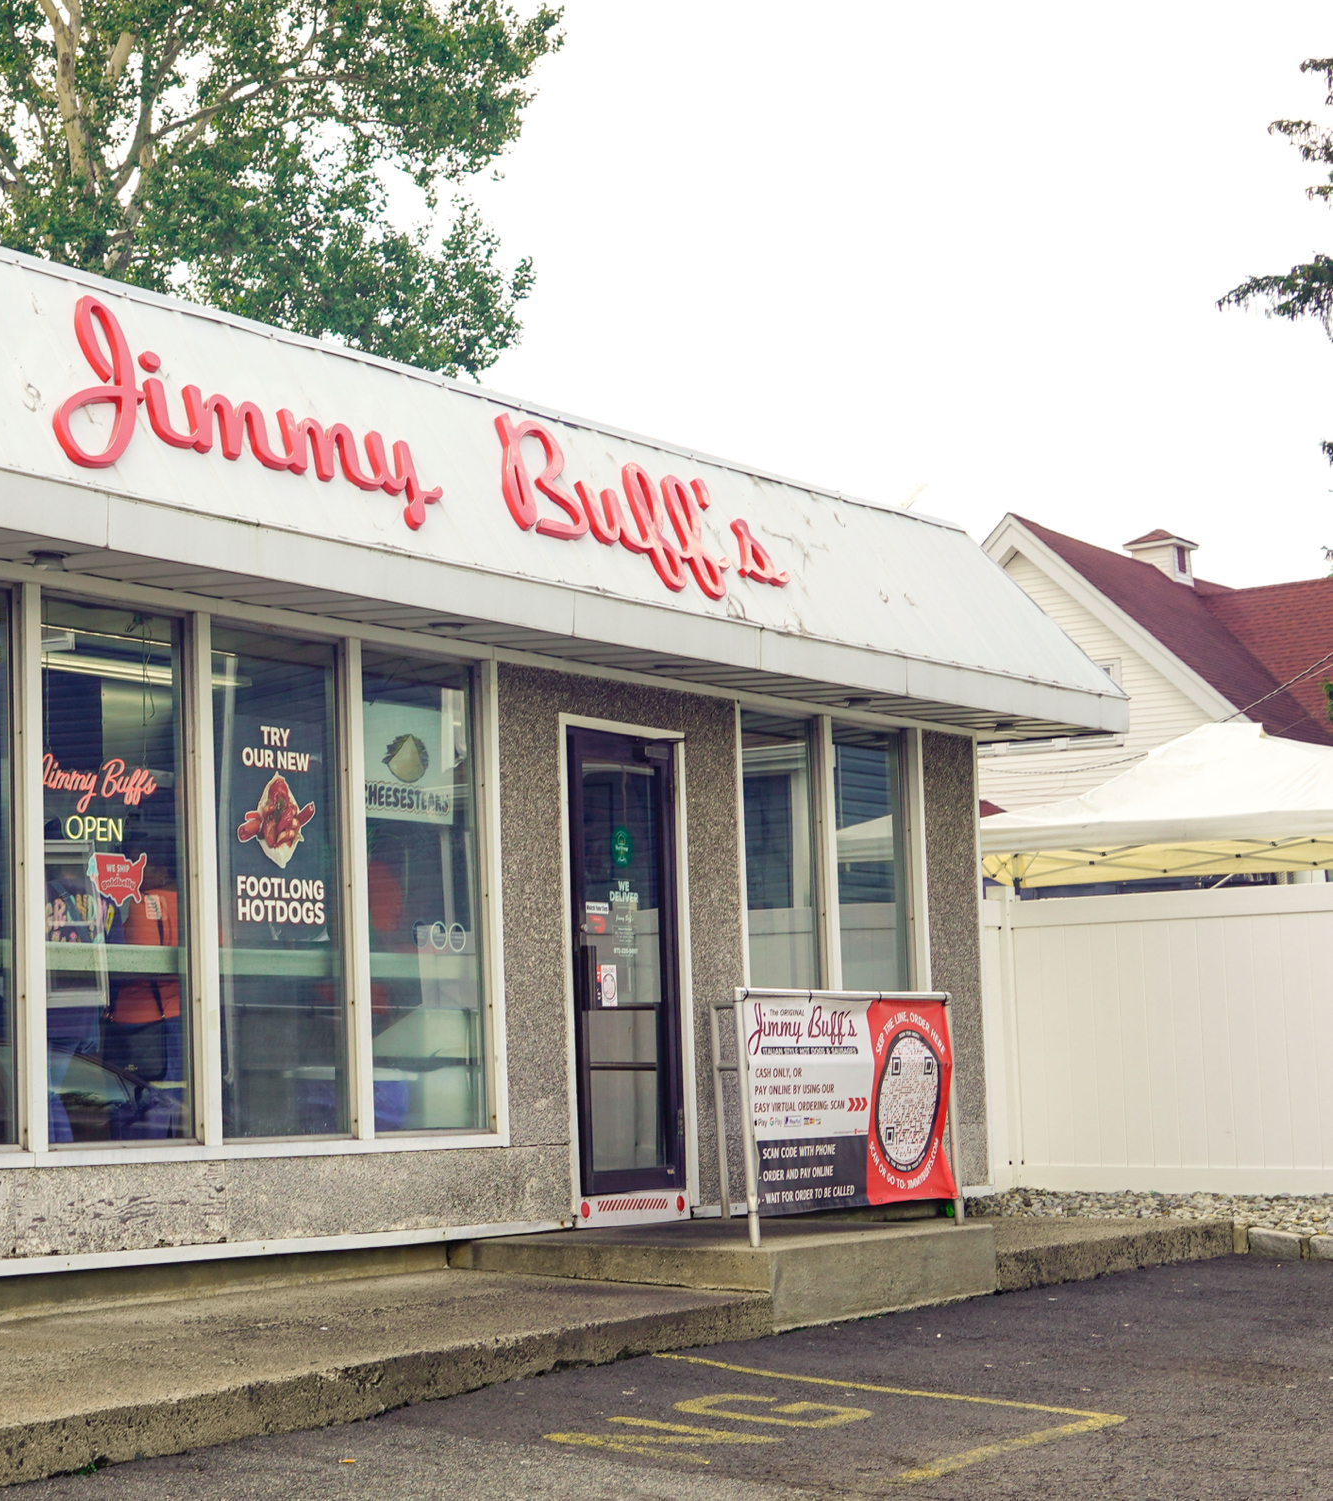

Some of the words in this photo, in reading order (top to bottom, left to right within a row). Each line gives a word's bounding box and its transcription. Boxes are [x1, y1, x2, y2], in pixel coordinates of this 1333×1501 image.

[53, 295, 443, 530] Jimmy
[494, 412, 790, 601] Buff's
[260, 725, 291, 748] TRY
[242, 747, 275, 769] OUR
[276, 751, 310, 772] NEW
[42, 753, 98, 813] Jimmy
[100, 758, 157, 805] Buffs
[66, 815, 124, 842] OPEN
[106, 864, 116, 872] WE
[116, 864, 130, 873] SHIP
[236, 875, 325, 900] FOOTLONG
[610, 891, 639, 902] DELIVER
[618, 880, 630, 892] WE
[237, 898, 325, 925] HOTDOGS
[748, 1003, 803, 1056] Jimmy
[808, 1006, 858, 1046] Buff's
[876, 1032, 885, 1056] SKIP
[883, 1018, 894, 1035] THE
[894, 1011, 909, 1025] LINE,
[910, 1012, 930, 1033] ORDER
[930, 1028, 946, 1056] HERE
[755, 1068, 772, 1078] CASH
[772, 1068, 791, 1078] ONLY,
[792, 1068, 802, 1078] OR
[754, 1086, 767, 1095] PAY
[768, 1085, 791, 1095] ONLINE
[792, 1085, 801, 1094] BY
[802, 1084, 820, 1094] USING
[822, 1084, 834, 1094] OUR
[754, 1103, 770, 1113] EASY
[771, 1102, 796, 1112] VIRTUAL
[798, 1101, 828, 1111] ORDERING:
[830, 1100, 845, 1110] SCAN
[758, 1118, 767, 1128] Pay
[762, 1148, 780, 1159] SCAN
[781, 1146, 797, 1158] CODE
[799, 1145, 814, 1157] WITH
[815, 1144, 836, 1156] PHONE
[763, 1170, 784, 1182] ORDER
[786, 1168, 798, 1180] AND
[800, 1167, 811, 1179] PAY
[812, 1165, 834, 1177] ONLINE
[869, 1141, 880, 1166] SCAN
[878, 1164, 886, 1178] OR
[887, 1173, 895, 1185] GO
[896, 1178, 906, 1189] TO:
[907, 1137, 939, 1189] JIMMYBUFFS.COM
[765, 1192, 780, 1204] WAIT
[782, 1191, 793, 1202] FOR
[795, 1189, 813, 1201] ORDER
[815, 1188, 822, 1199] TO
[824, 1187, 831, 1198] BE
[833, 1185, 855, 1196] CALLED
